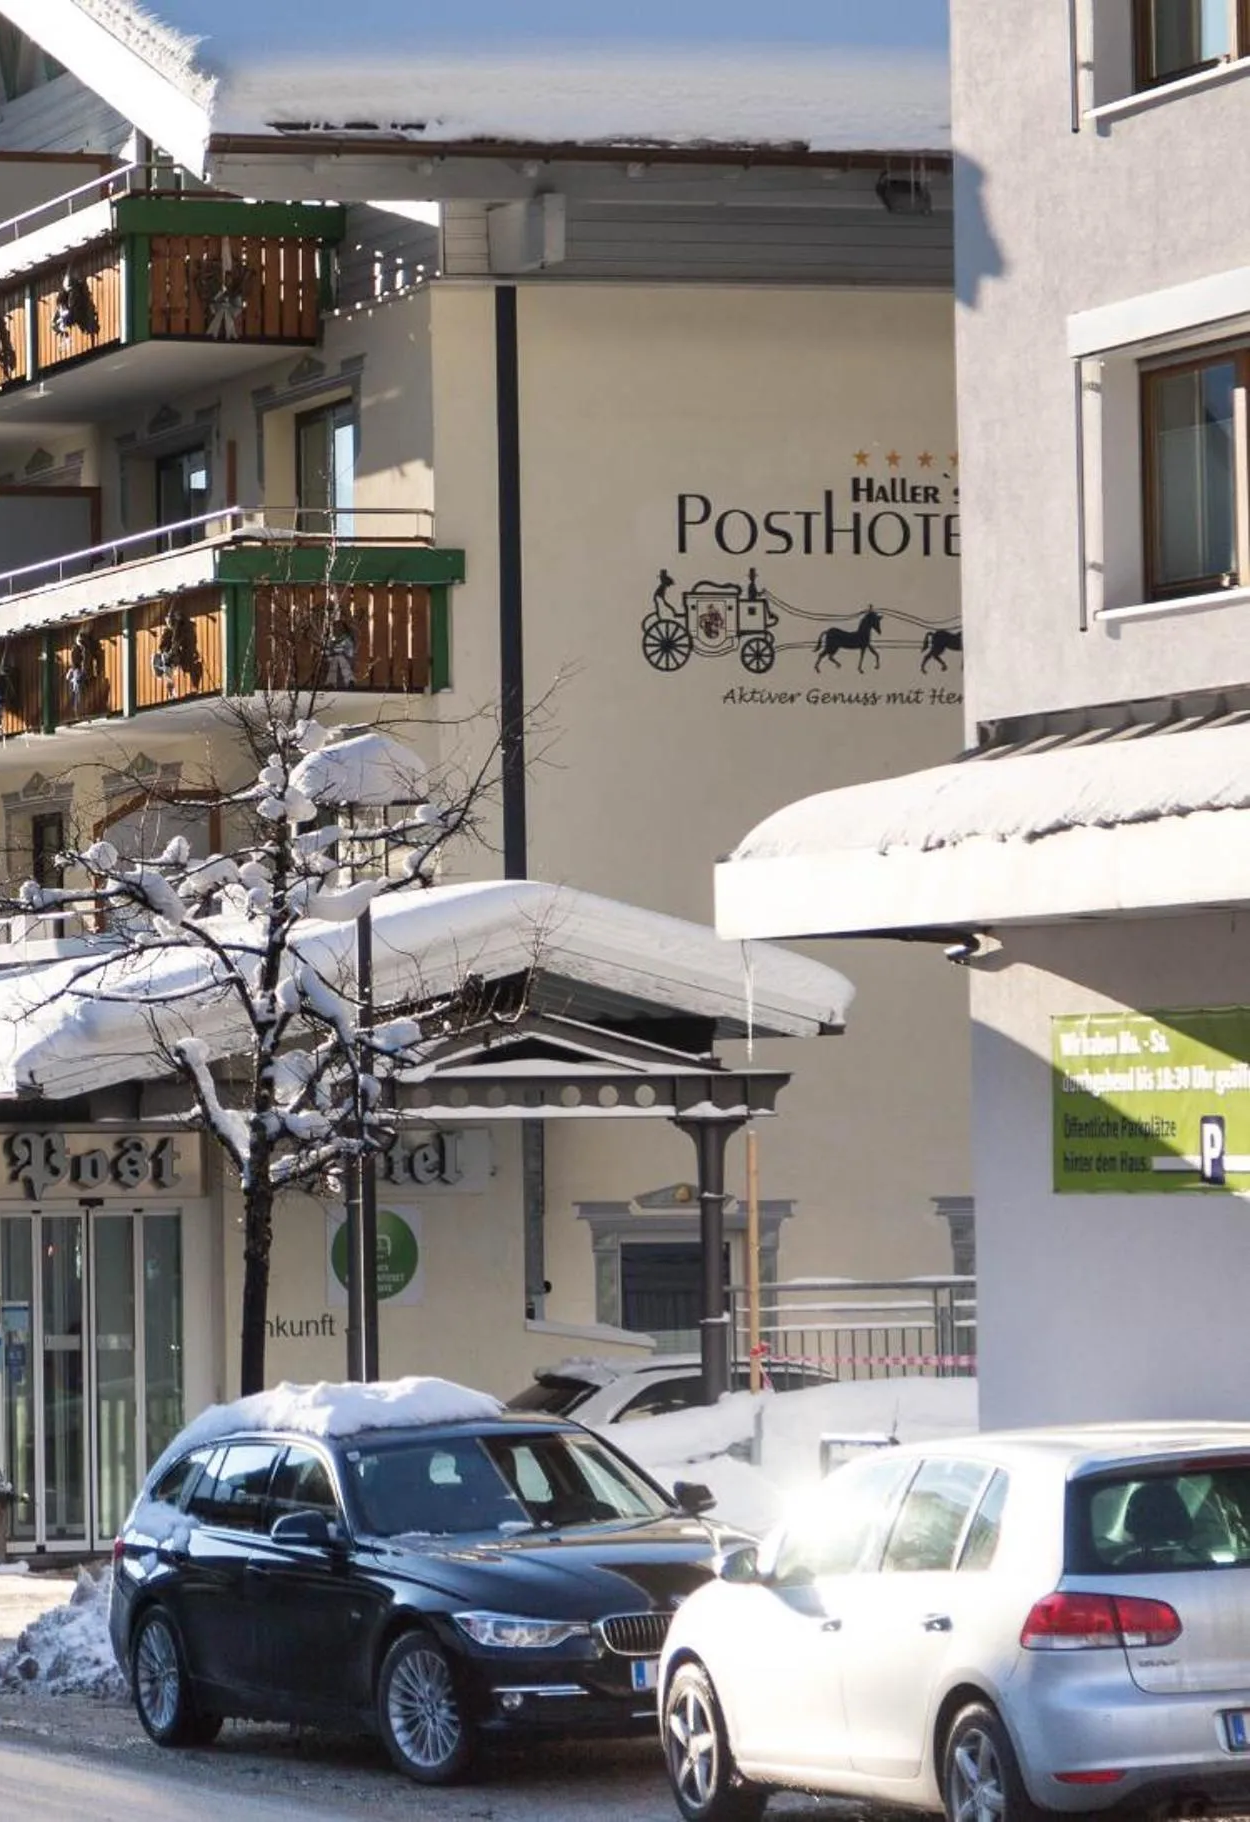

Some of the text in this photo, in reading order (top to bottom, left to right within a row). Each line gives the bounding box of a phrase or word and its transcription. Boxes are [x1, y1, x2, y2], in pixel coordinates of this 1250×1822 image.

[677, 489, 961, 557] POSTHOTE
[722, 687, 964, 706] Aktiver Genuss mit Her
[1121, 1112, 1176, 1141] Parkplätze
[4, 1132, 182, 1201] Post
[263, 1312, 337, 1338] nkunft
